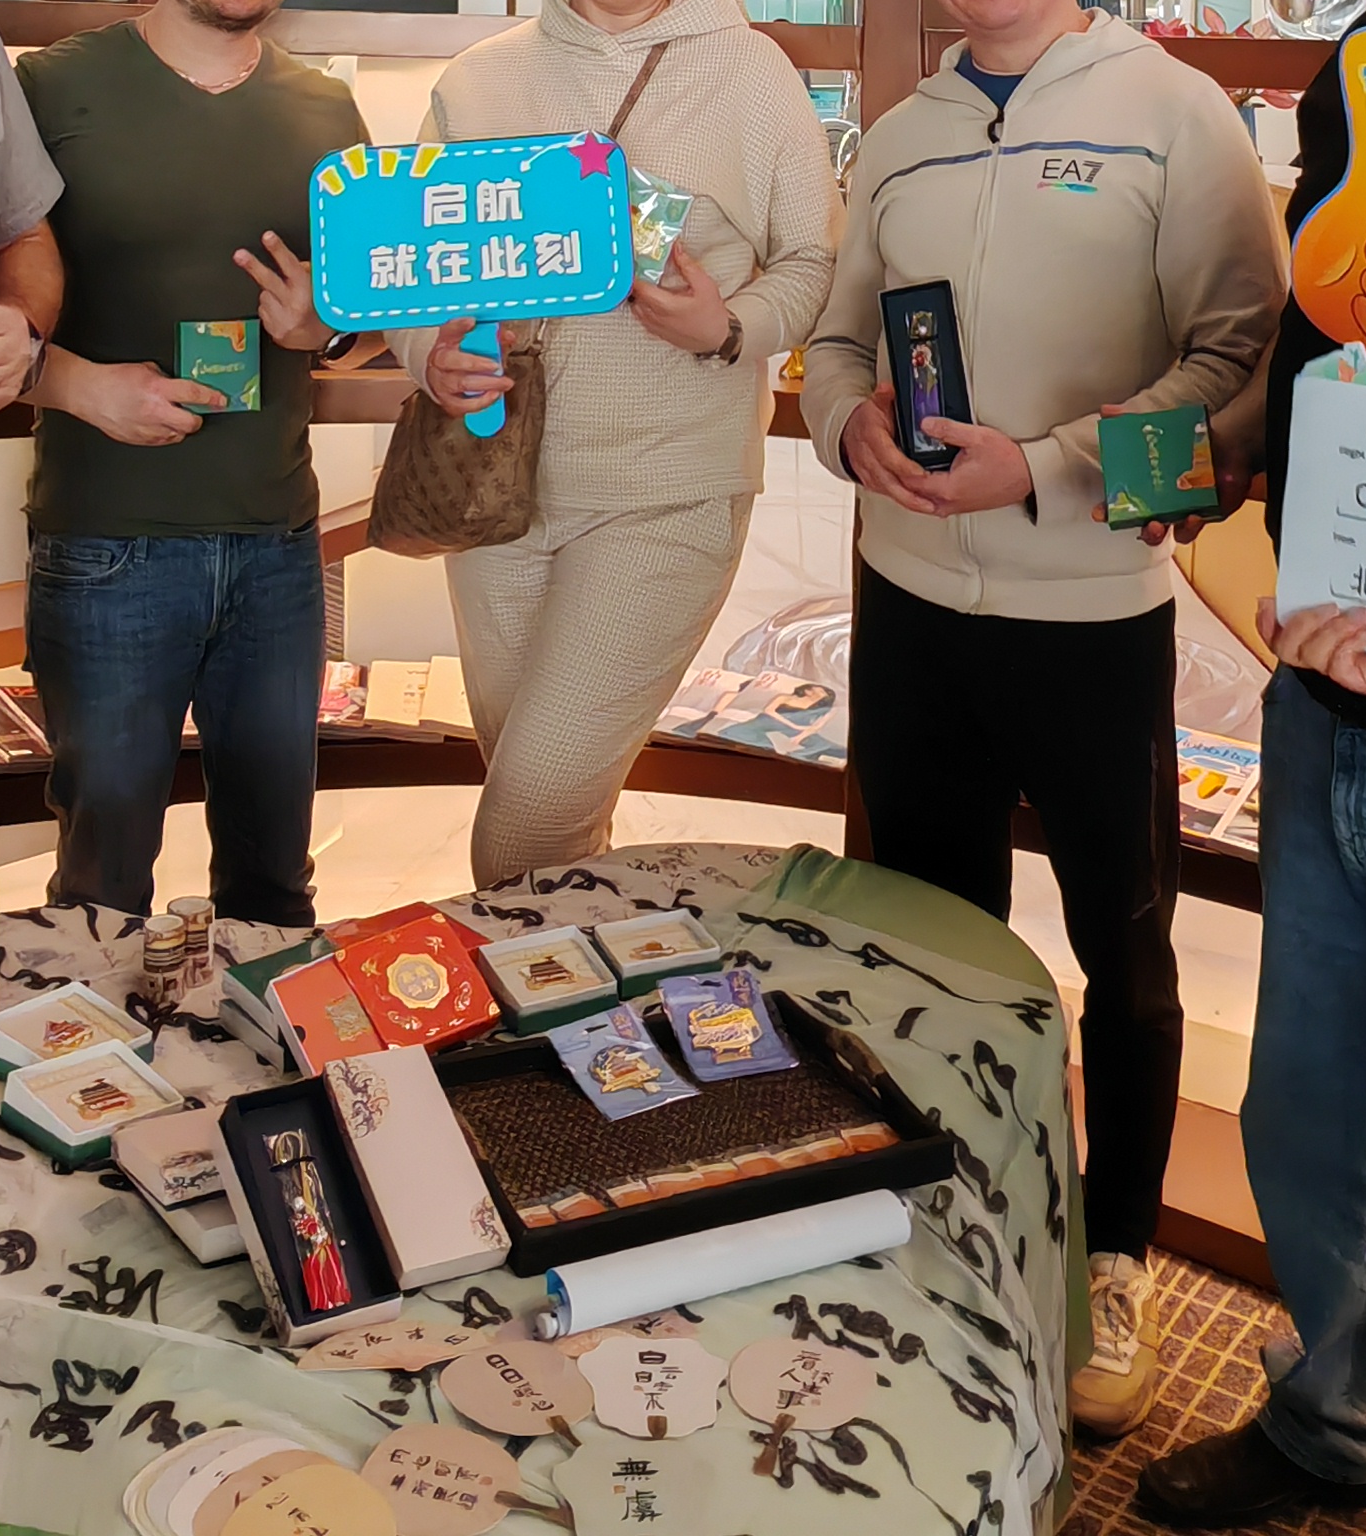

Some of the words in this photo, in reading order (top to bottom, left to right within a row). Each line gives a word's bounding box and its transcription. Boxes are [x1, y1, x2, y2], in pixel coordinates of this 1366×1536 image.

[1041, 158, 1105, 183] EA7
[423, 177, 523, 227] 启航
[368, 230, 582, 290] 就在此刻
